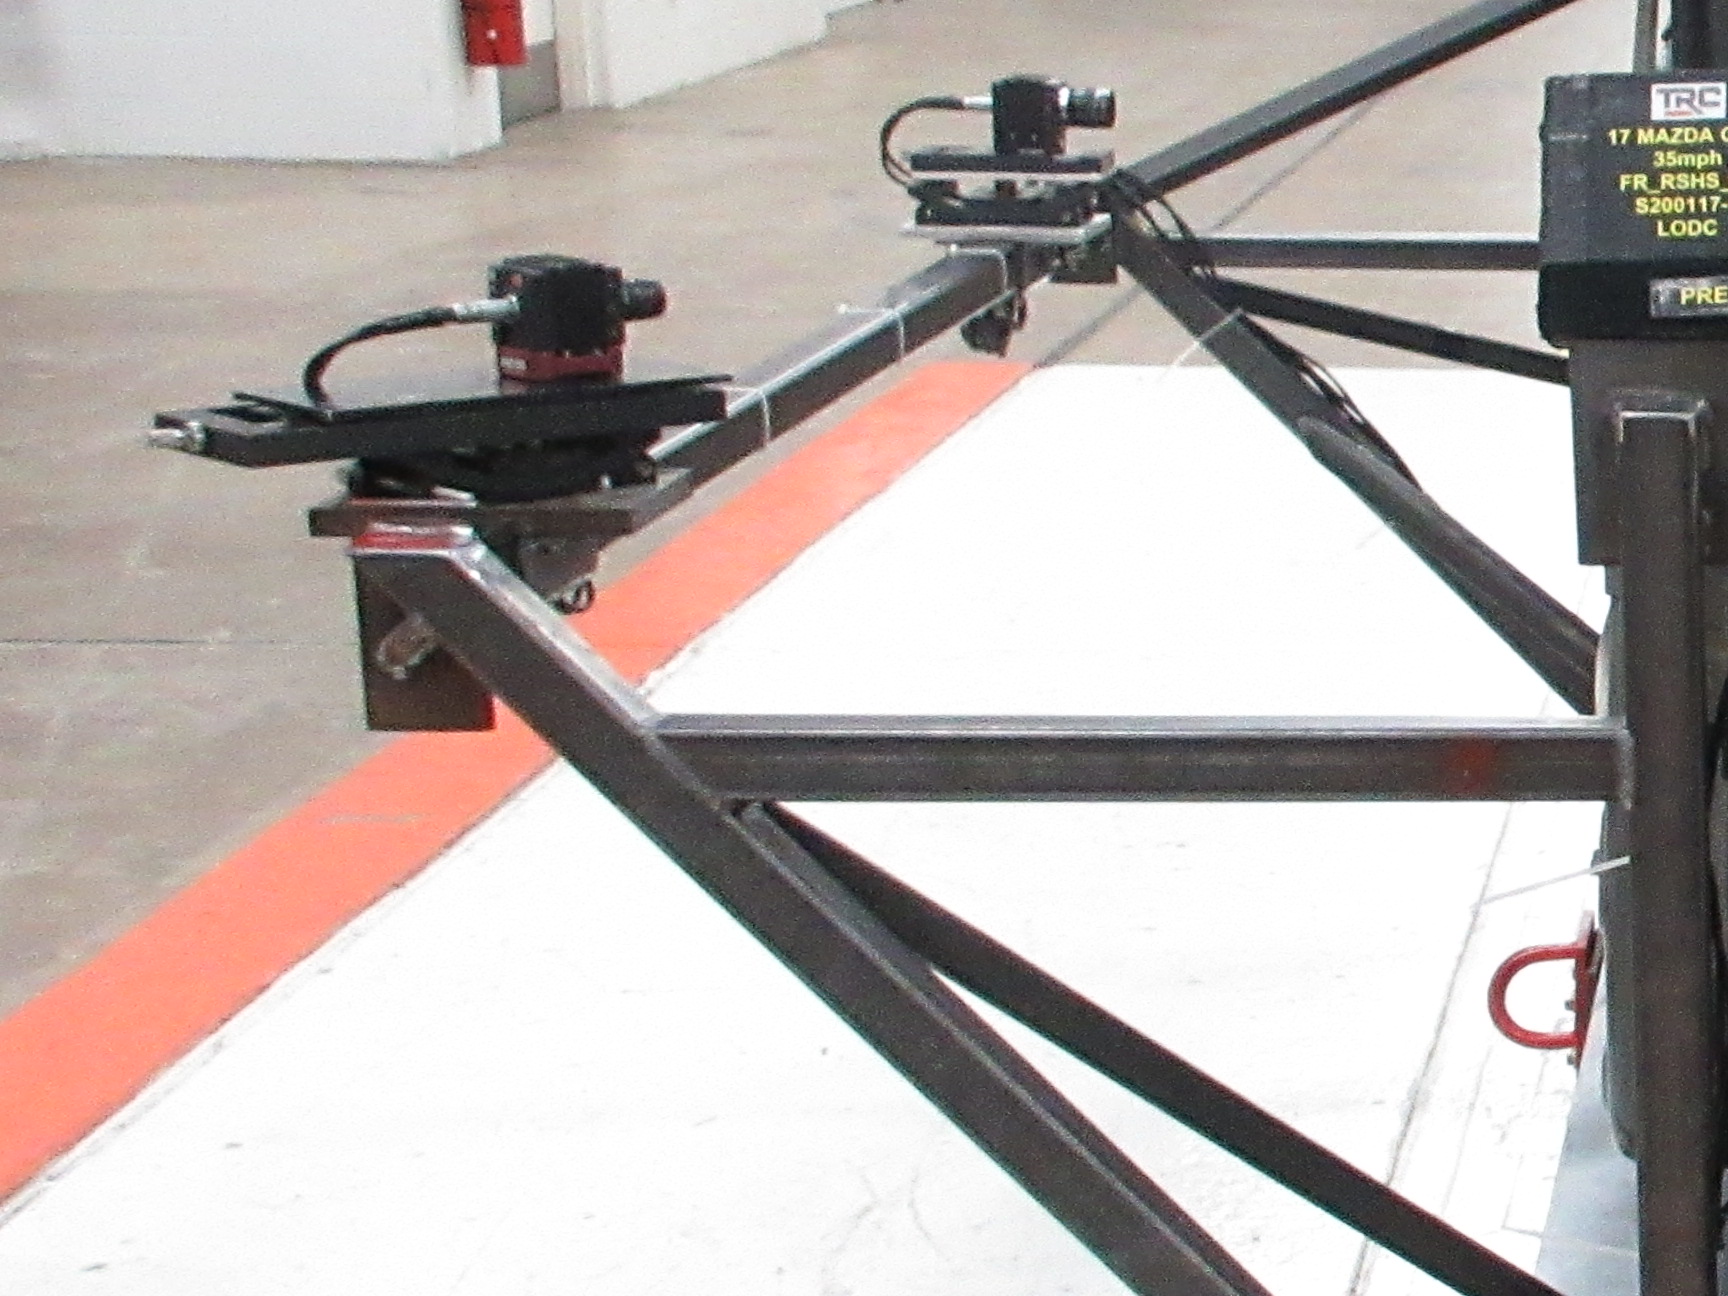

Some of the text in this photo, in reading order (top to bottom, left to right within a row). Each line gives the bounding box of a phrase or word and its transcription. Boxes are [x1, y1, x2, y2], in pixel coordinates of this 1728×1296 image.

[1656, 86, 1721, 115] TRC
[1608, 128, 1631, 146] 17
[1636, 126, 1715, 145] MAZDA
[1653, 149, 1722, 169] 35mph
[1656, 218, 1718, 237] LODC
[1680, 285, 1728, 305] PRE
